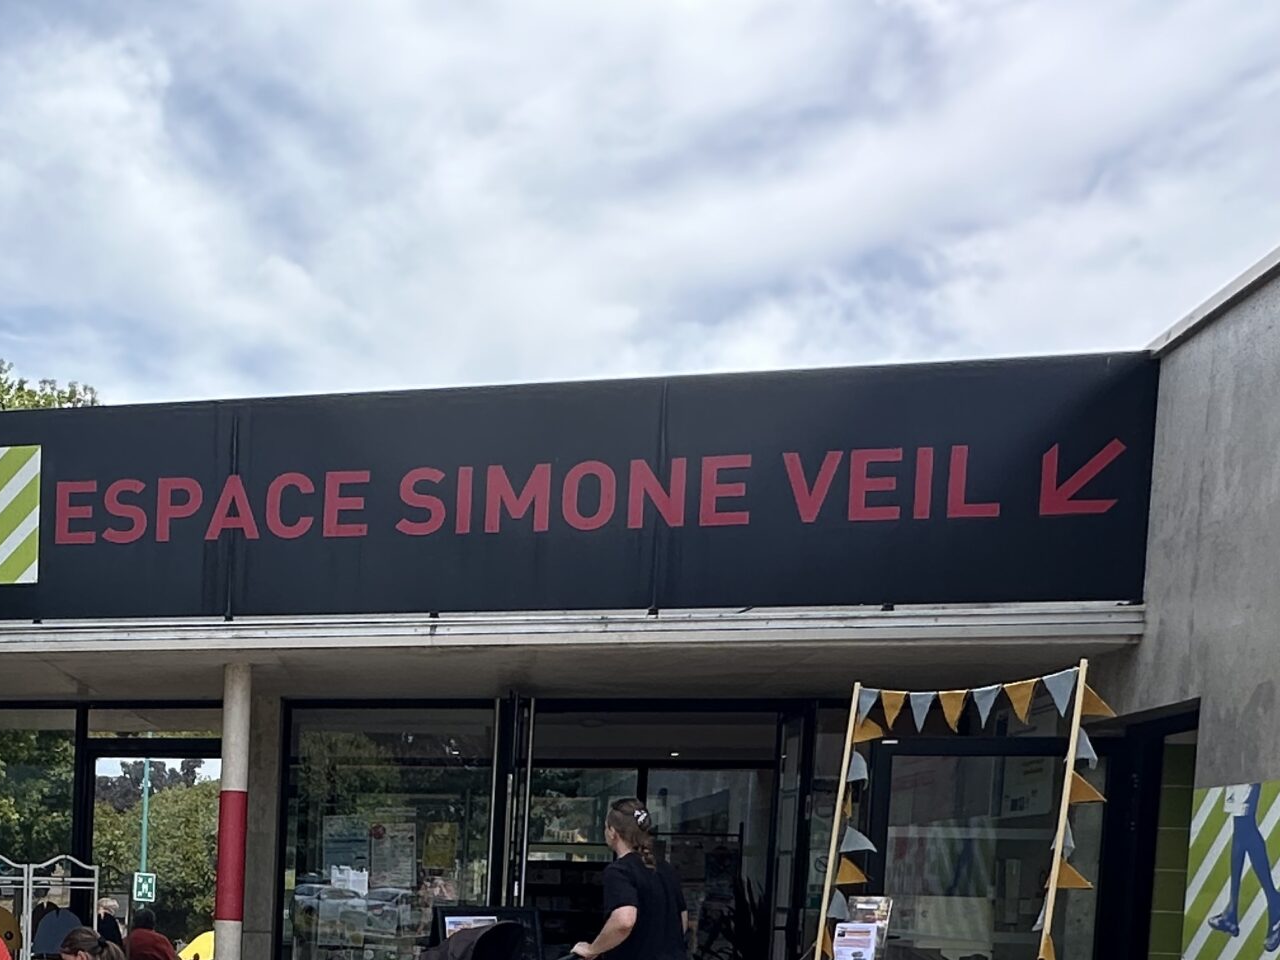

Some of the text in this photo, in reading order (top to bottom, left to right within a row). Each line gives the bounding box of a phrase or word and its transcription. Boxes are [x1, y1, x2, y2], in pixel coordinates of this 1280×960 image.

[54, 445, 1000, 545] ESPACE SIMONE VEIL
